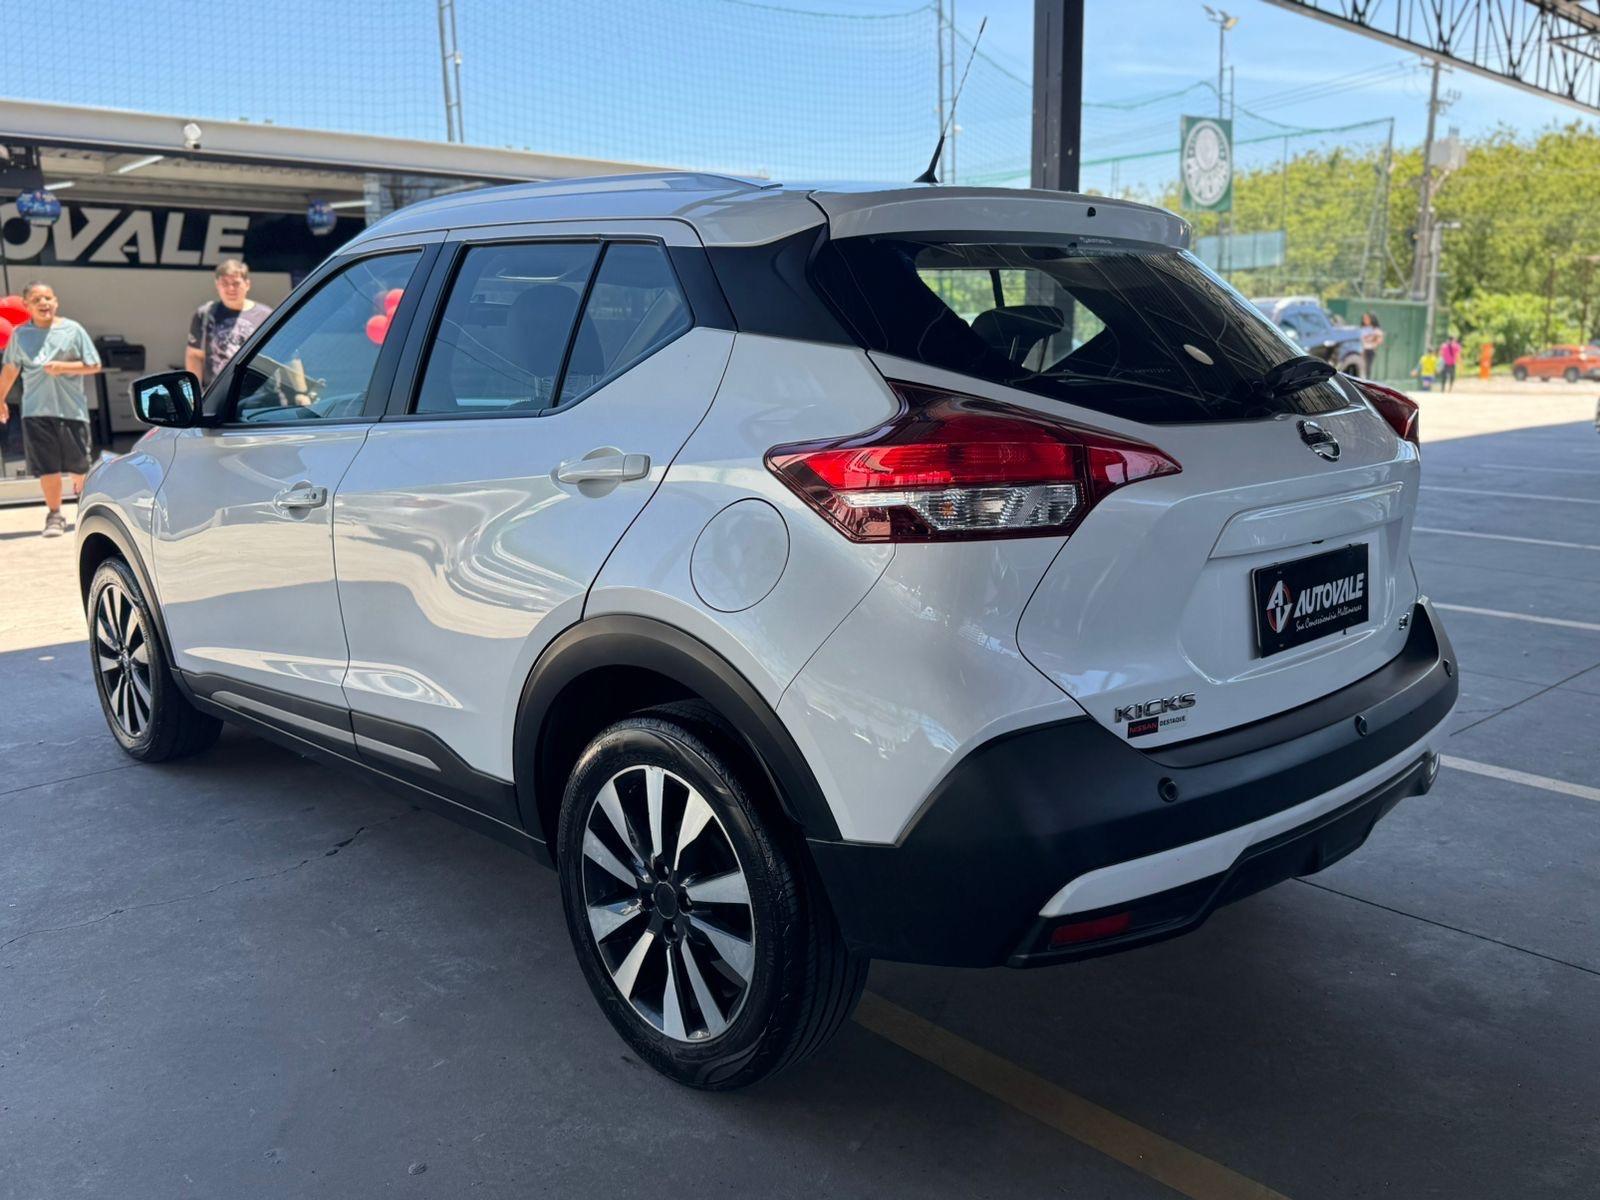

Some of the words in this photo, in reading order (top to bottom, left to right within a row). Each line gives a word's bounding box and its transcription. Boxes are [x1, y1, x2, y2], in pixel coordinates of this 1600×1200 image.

[1293, 573, 1364, 618] AUTOVALE
[1114, 692, 1196, 723] KICKS
[1129, 722, 1157, 734] NISSAN
